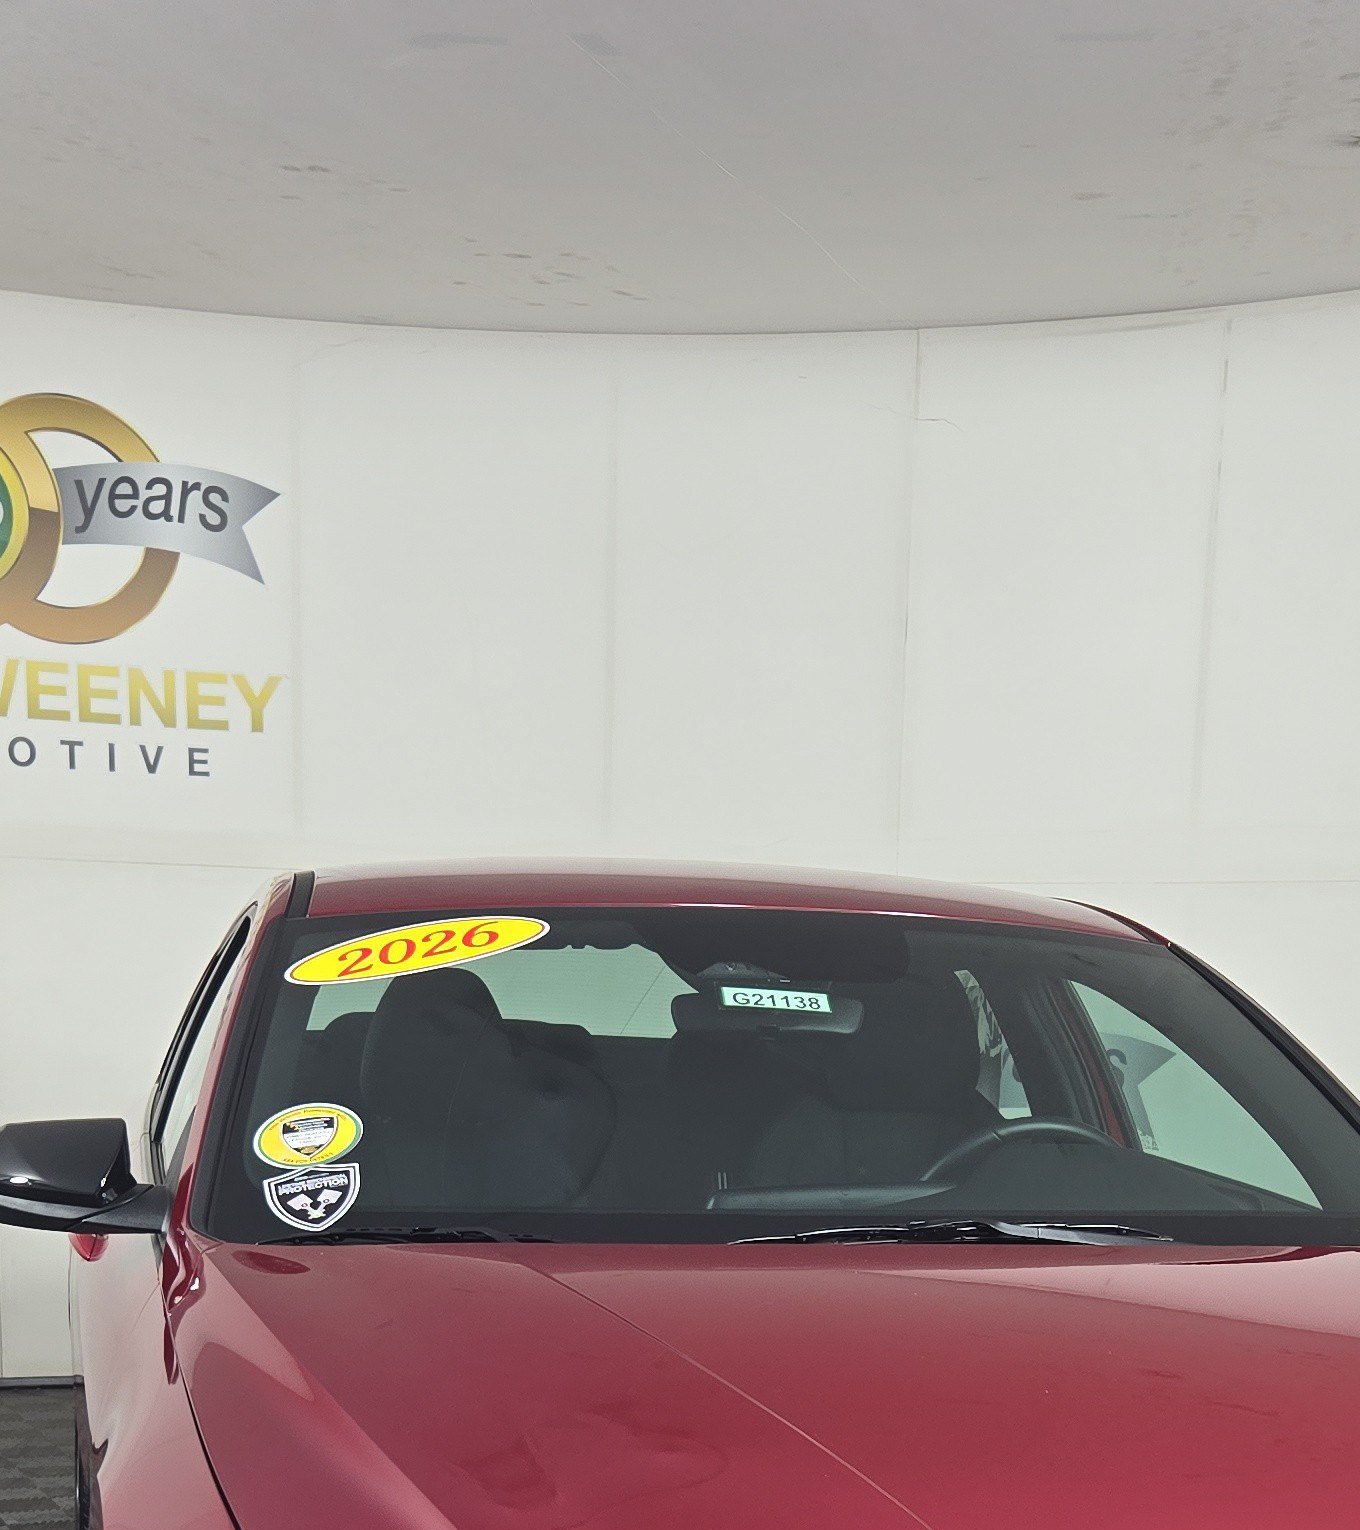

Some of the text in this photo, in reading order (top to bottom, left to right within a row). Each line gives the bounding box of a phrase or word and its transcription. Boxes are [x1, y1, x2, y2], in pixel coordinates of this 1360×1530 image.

[73, 473, 230, 533] years
[337, 921, 499, 977] 2026
[732, 992, 821, 1010] G21138
